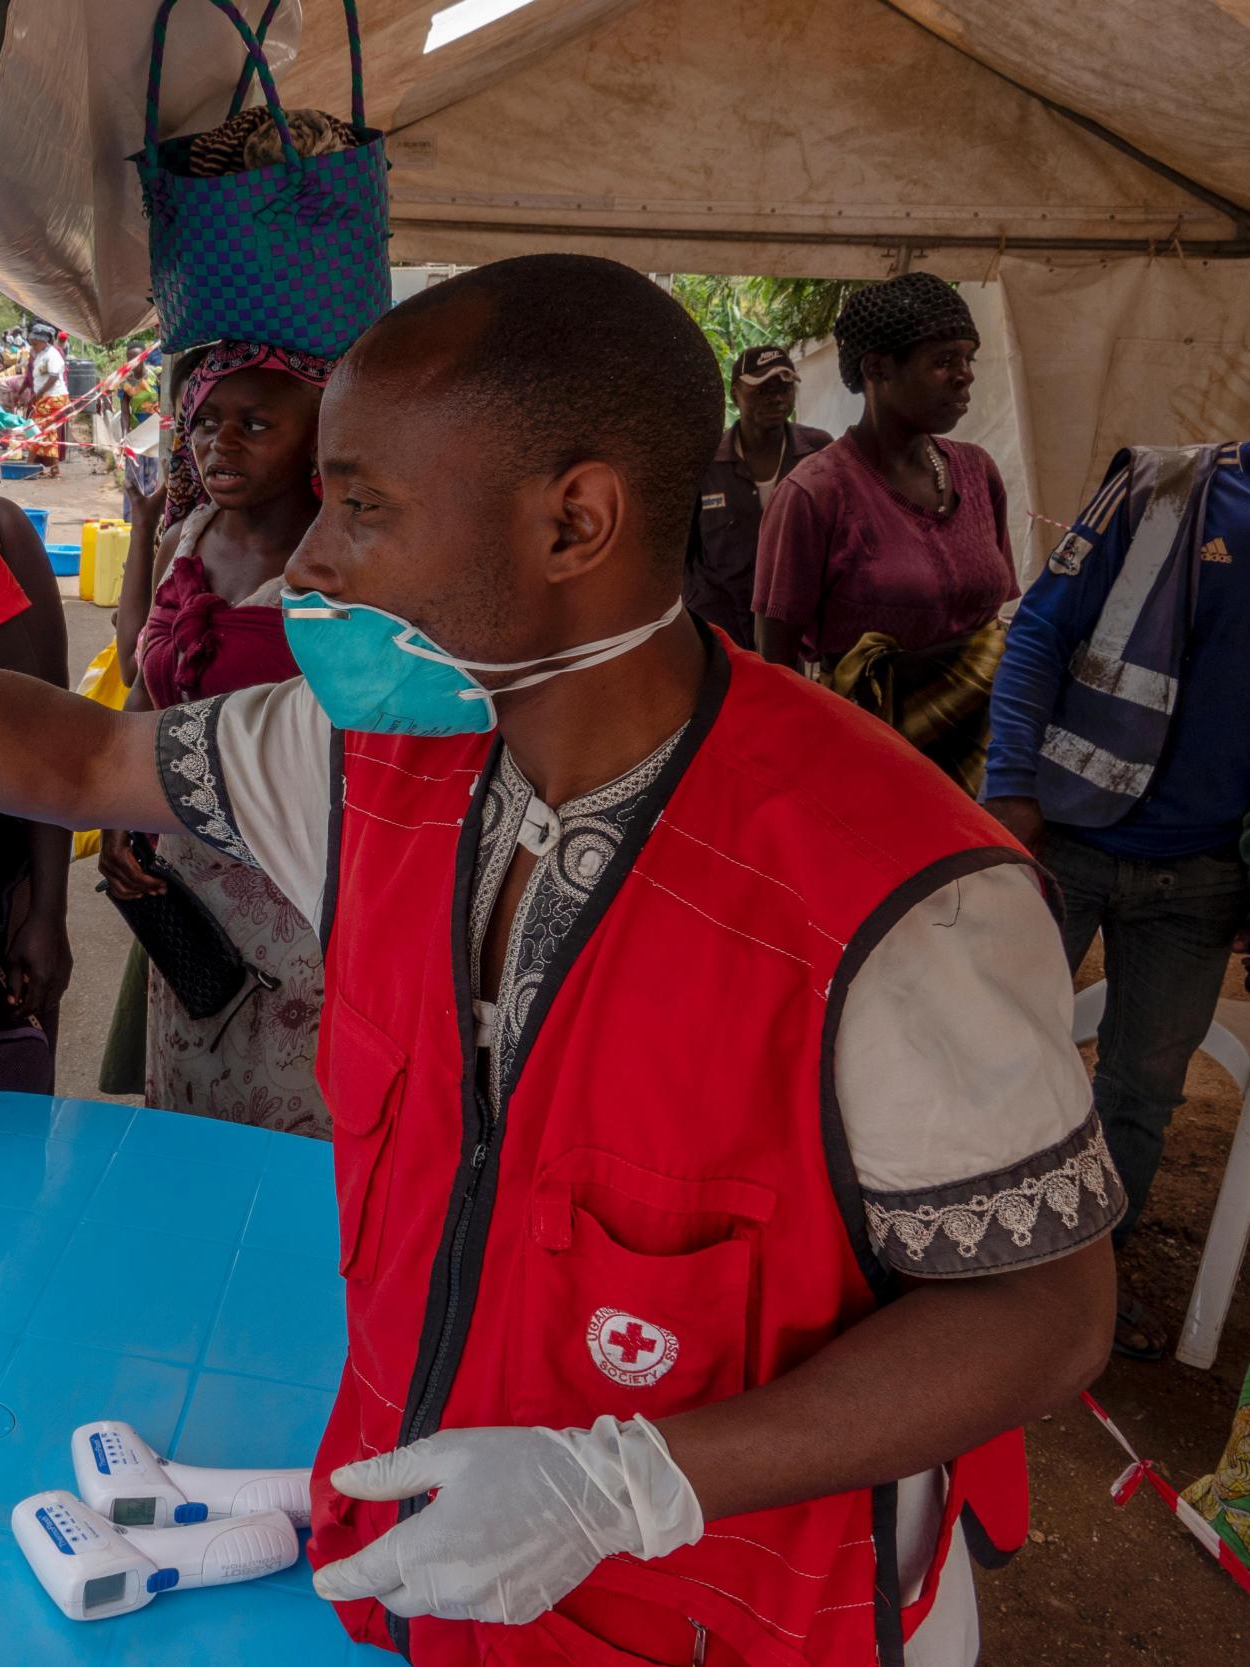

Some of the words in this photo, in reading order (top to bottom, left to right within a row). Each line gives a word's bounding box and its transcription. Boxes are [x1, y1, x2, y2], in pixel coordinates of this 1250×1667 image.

[1201, 553, 1232, 564] didas
[588, 1306, 618, 1341] UGAND
[600, 1360, 658, 1384] SOCIETY
